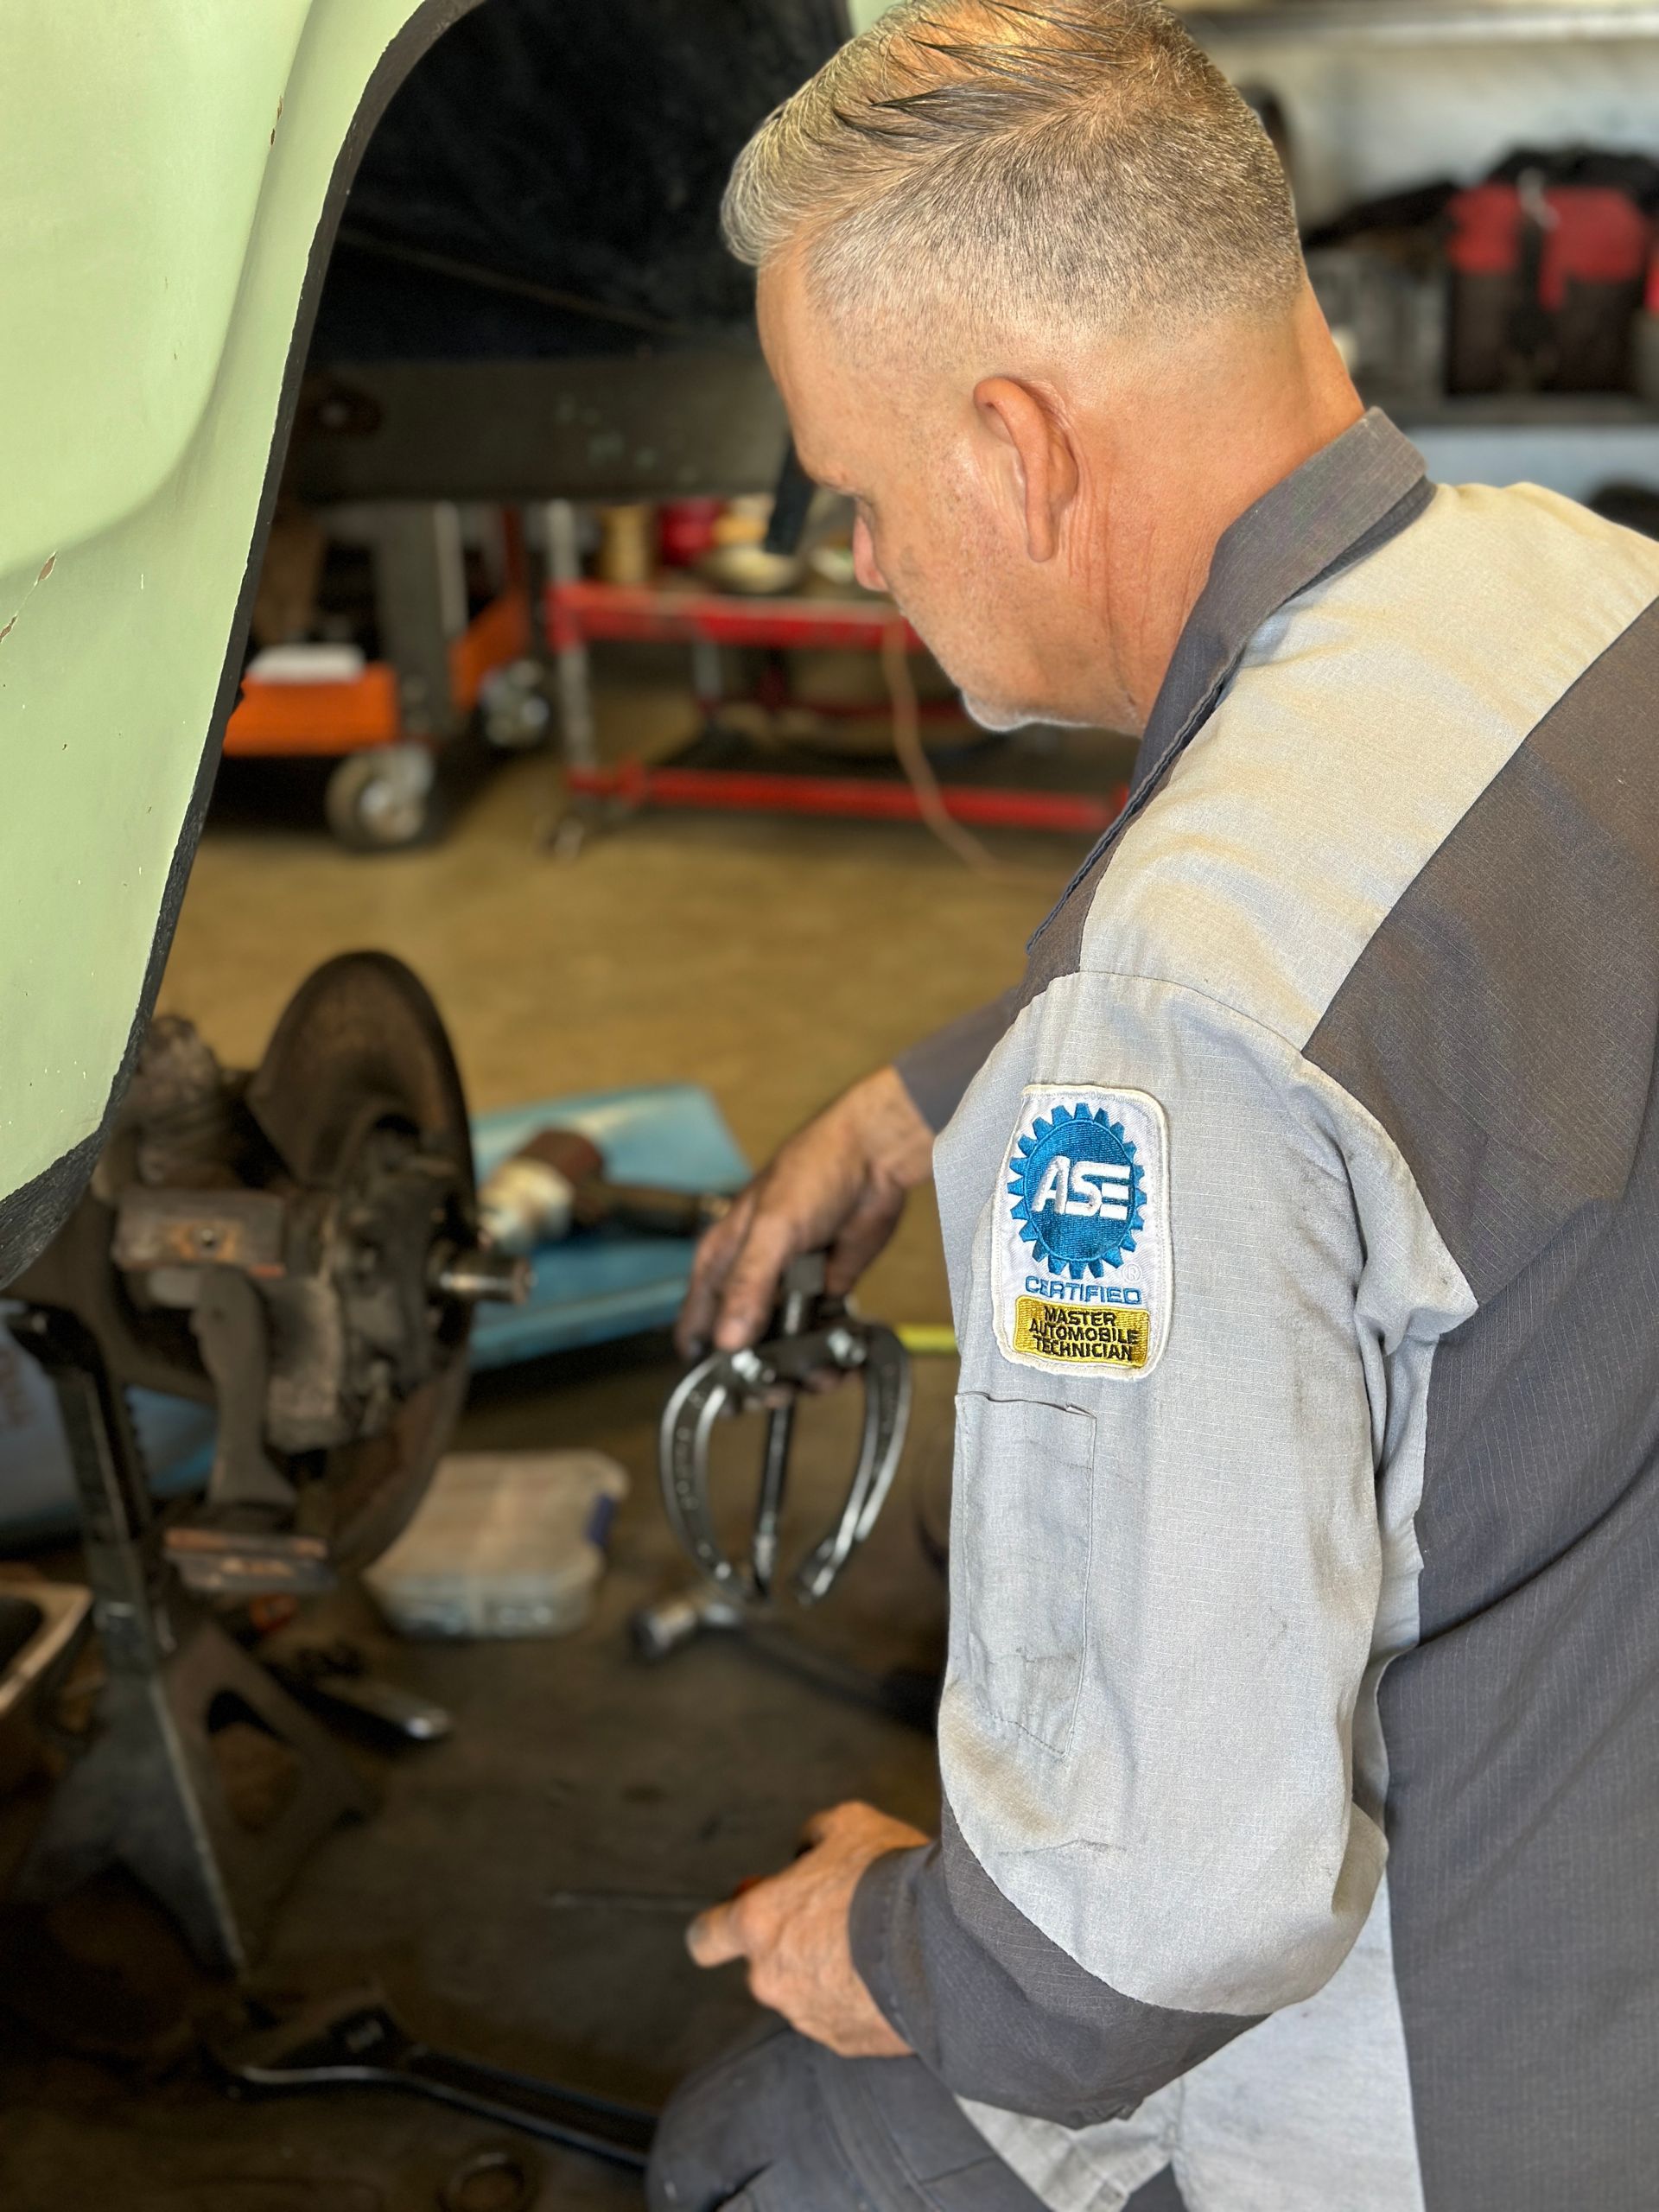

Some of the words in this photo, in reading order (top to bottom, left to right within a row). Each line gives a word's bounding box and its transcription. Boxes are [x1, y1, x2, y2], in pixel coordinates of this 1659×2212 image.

[1032, 1156, 1131, 1219] ASE
[1027, 1276, 1141, 1303] CERTIFIED
[1044, 1306, 1116, 1326] MASTER
[1029, 1319, 1138, 1344] AUTOMOBILE
[1033, 1335, 1133, 1361] TECHNICIAN
